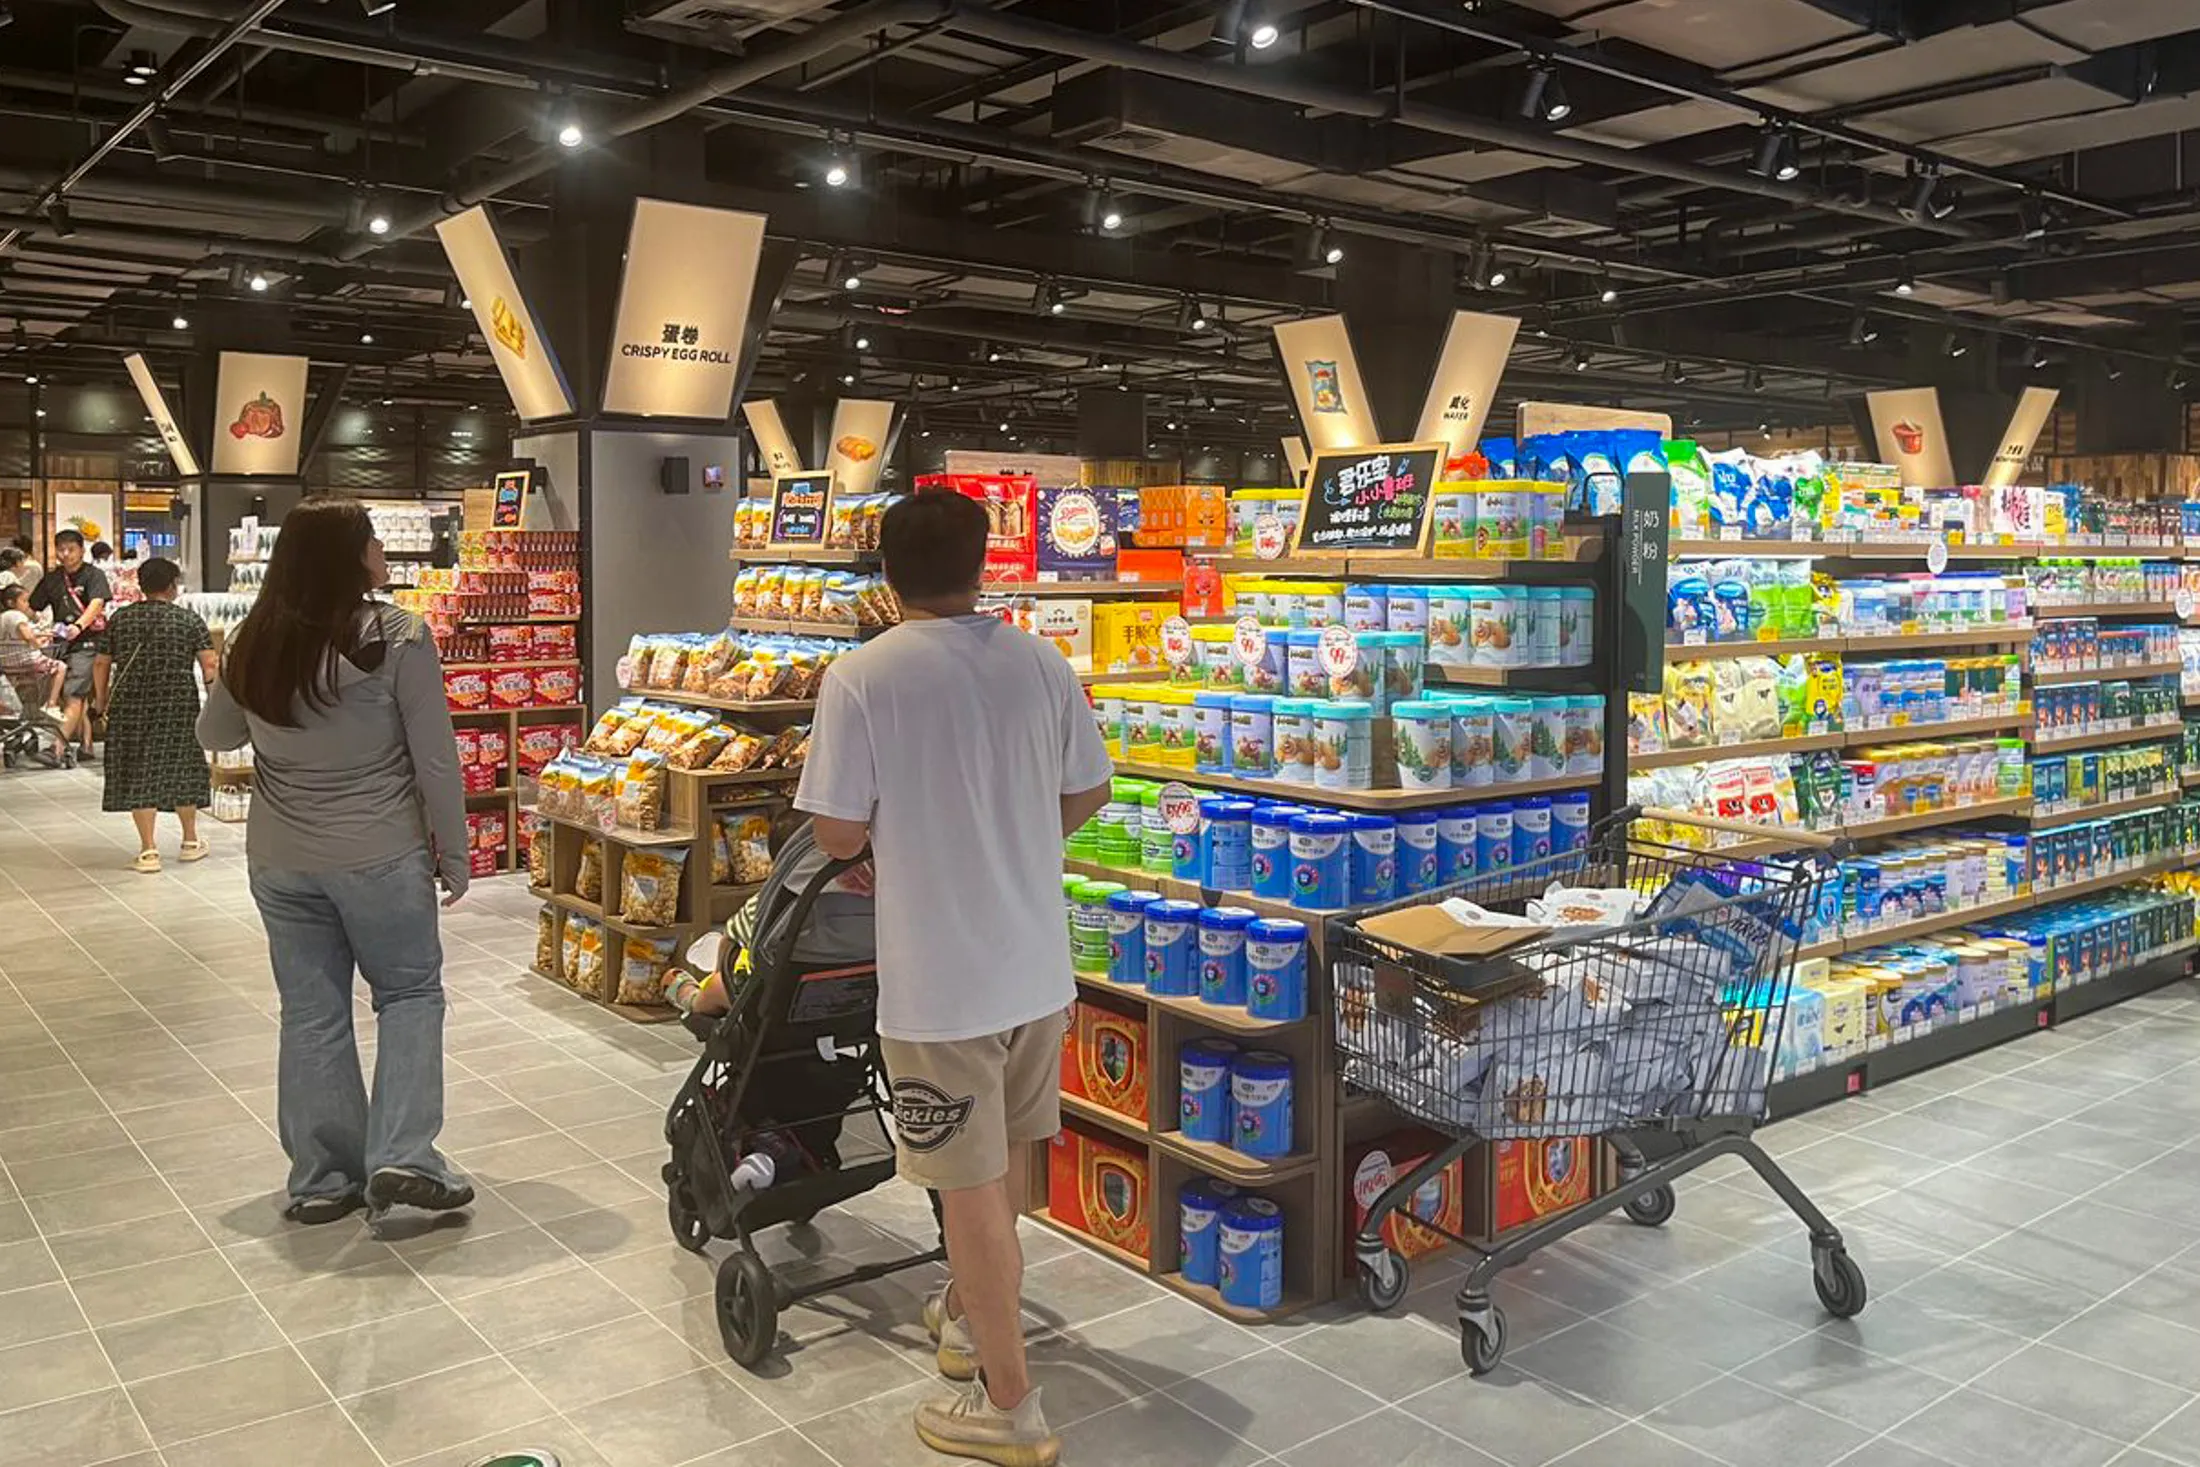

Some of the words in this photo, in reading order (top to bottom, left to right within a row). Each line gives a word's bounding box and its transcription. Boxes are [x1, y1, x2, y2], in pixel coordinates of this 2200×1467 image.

[662, 323, 698, 345] 蛋卷
[621, 344, 670, 359] CRISPY
[671, 348, 698, 361] EGG
[699, 350, 731, 364] ROLL
[1643, 509, 1660, 561] 奶粉
[893, 1105, 961, 1122] ckies
